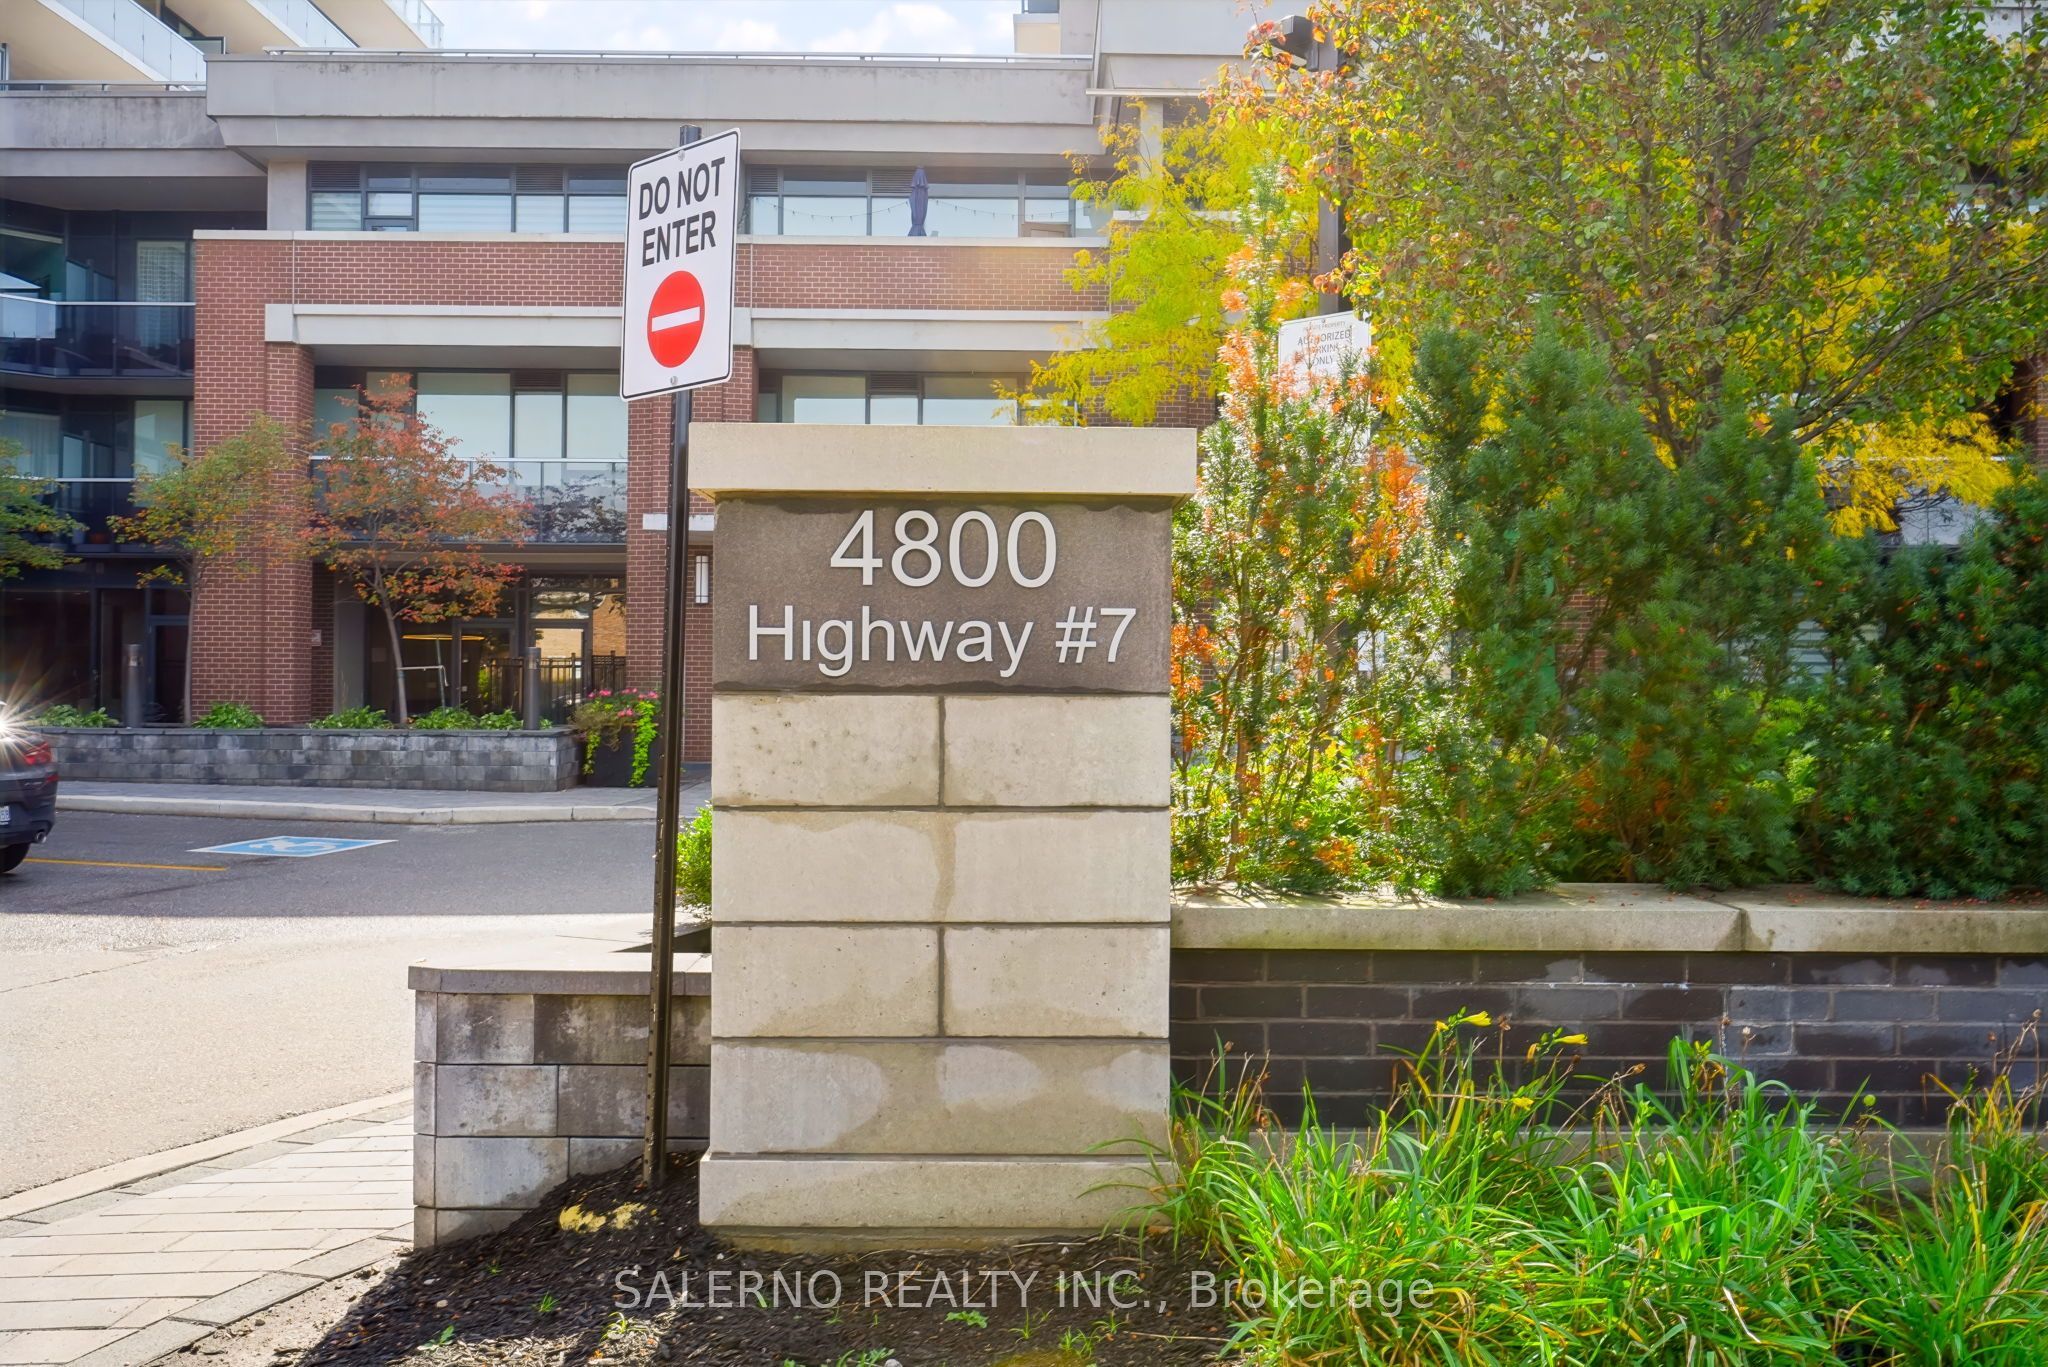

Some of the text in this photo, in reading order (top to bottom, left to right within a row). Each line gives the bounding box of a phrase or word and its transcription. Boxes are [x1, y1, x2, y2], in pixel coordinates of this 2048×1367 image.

[639, 156, 725, 220] DO NOT
[642, 210, 716, 267] ENTER
[830, 510, 1057, 588] 4800
[748, 604, 1137, 678] Highway #7
